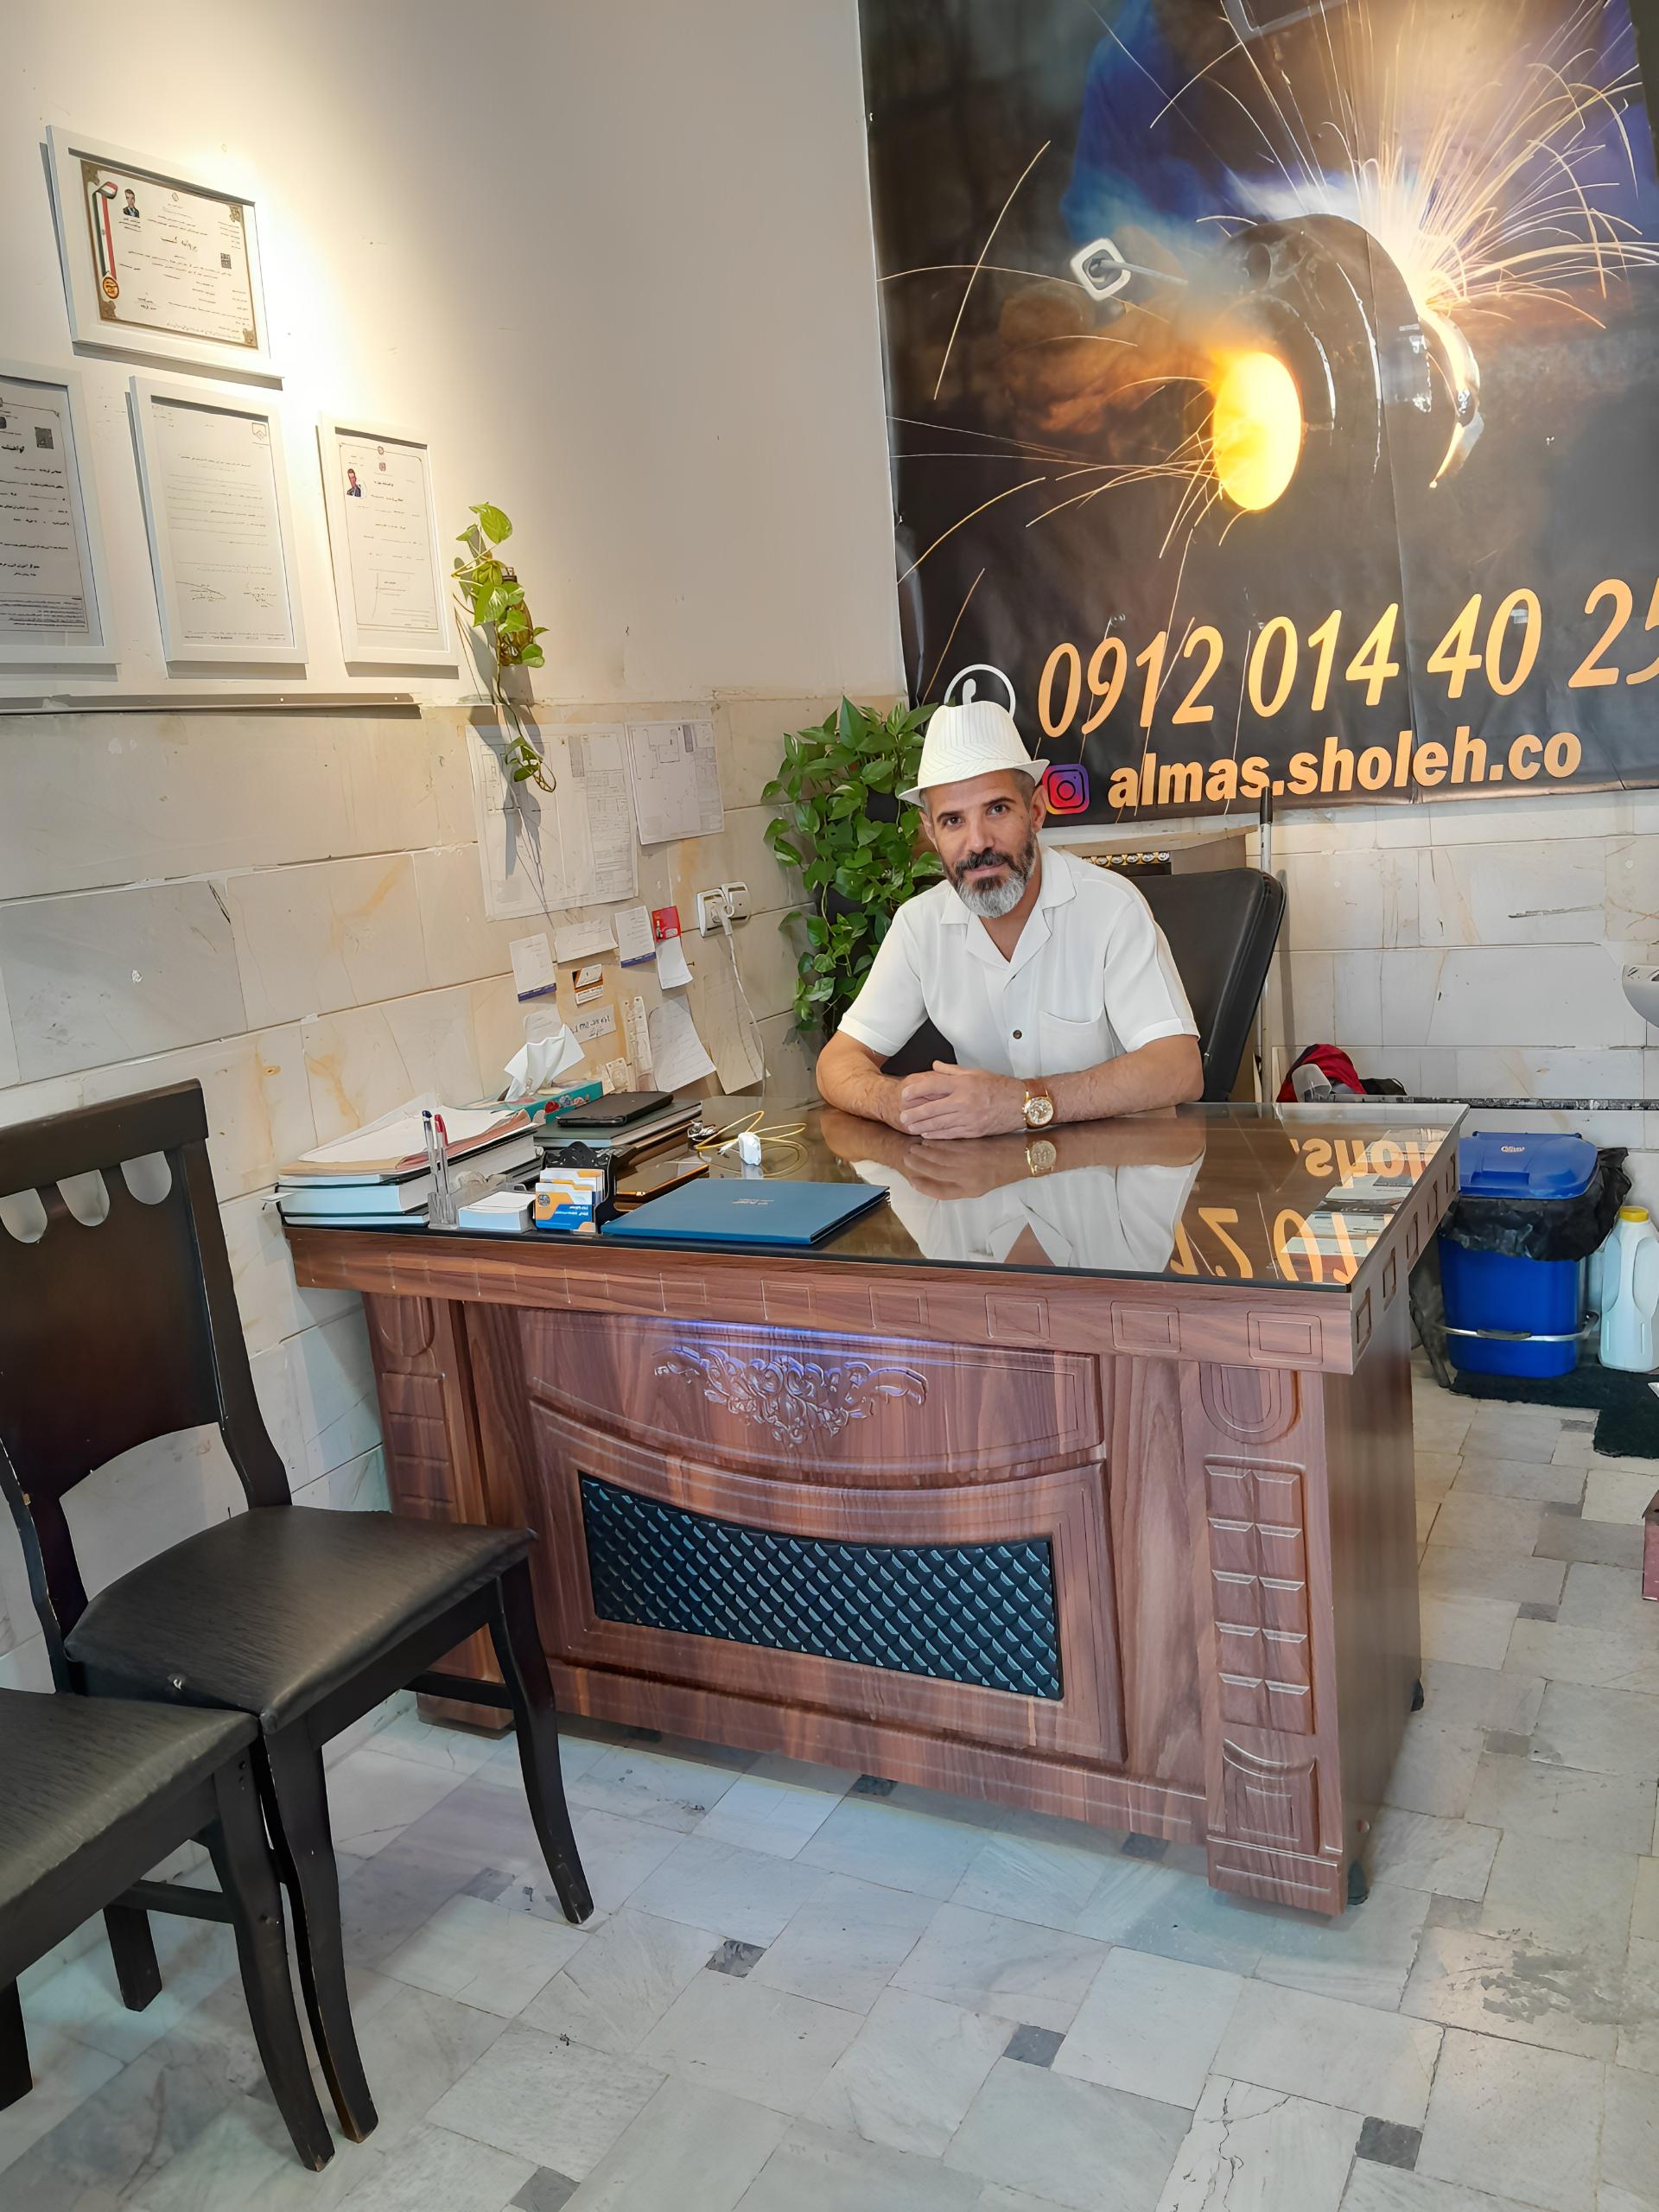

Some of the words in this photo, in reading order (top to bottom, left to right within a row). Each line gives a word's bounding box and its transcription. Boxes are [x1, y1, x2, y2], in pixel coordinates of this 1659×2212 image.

[1038, 626, 1224, 738] 0912
[1249, 603, 1399, 717] 014
[1427, 588, 1541, 699] 40
[1108, 726, 1582, 808] almas.sholeh.co
